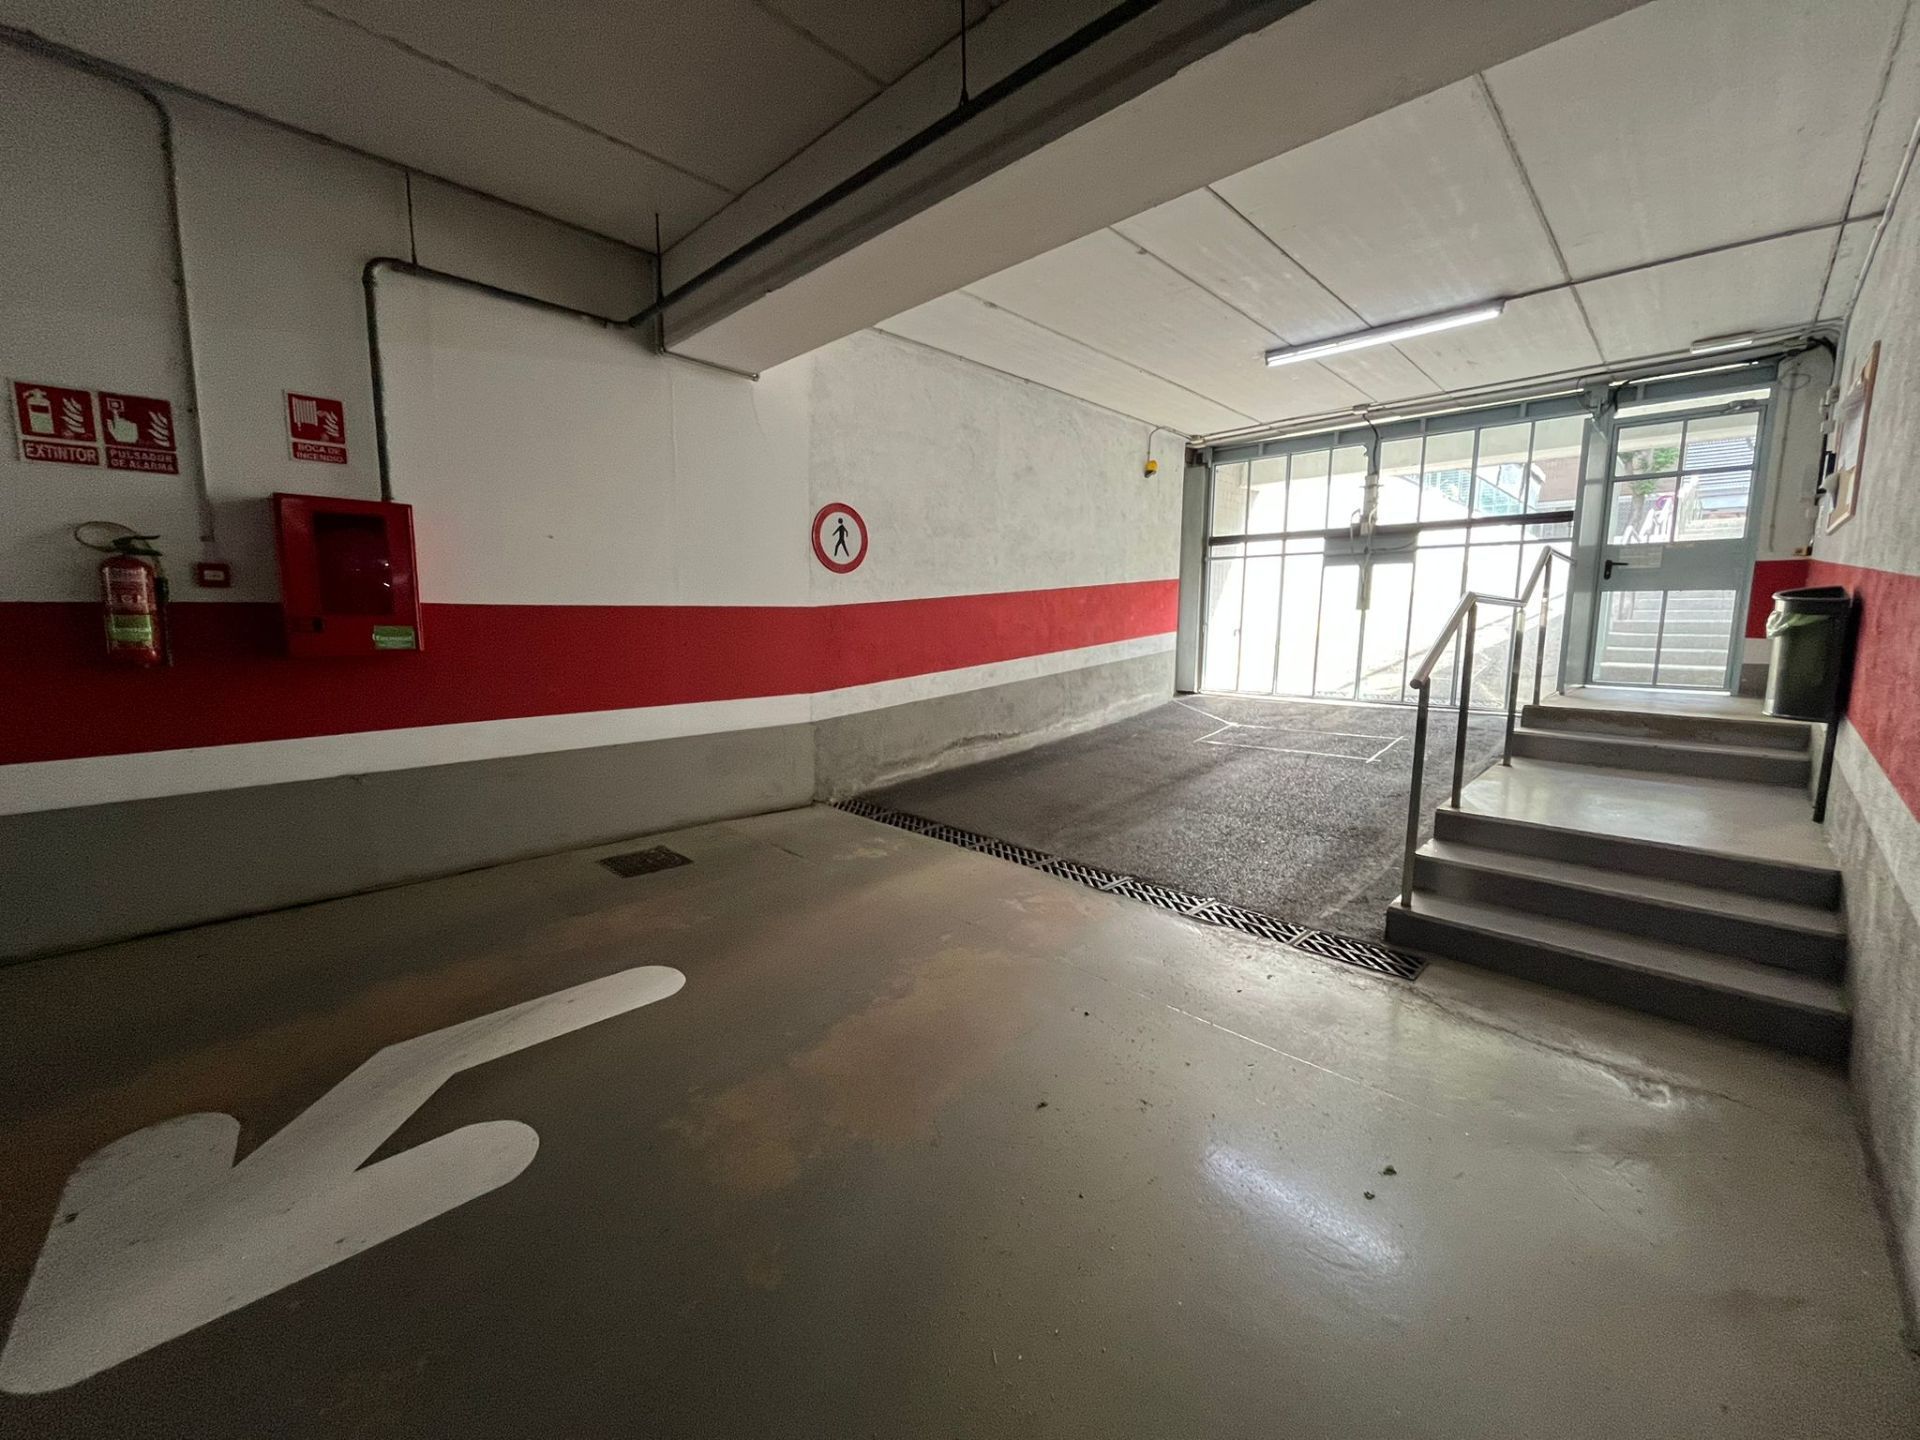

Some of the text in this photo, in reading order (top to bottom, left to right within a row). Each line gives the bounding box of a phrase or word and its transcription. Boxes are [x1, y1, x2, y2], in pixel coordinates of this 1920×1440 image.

[25, 443, 98, 463] EXTINTOR
[110, 448, 173, 463] PULSADOR
[129, 460, 175, 473] ALARMA
